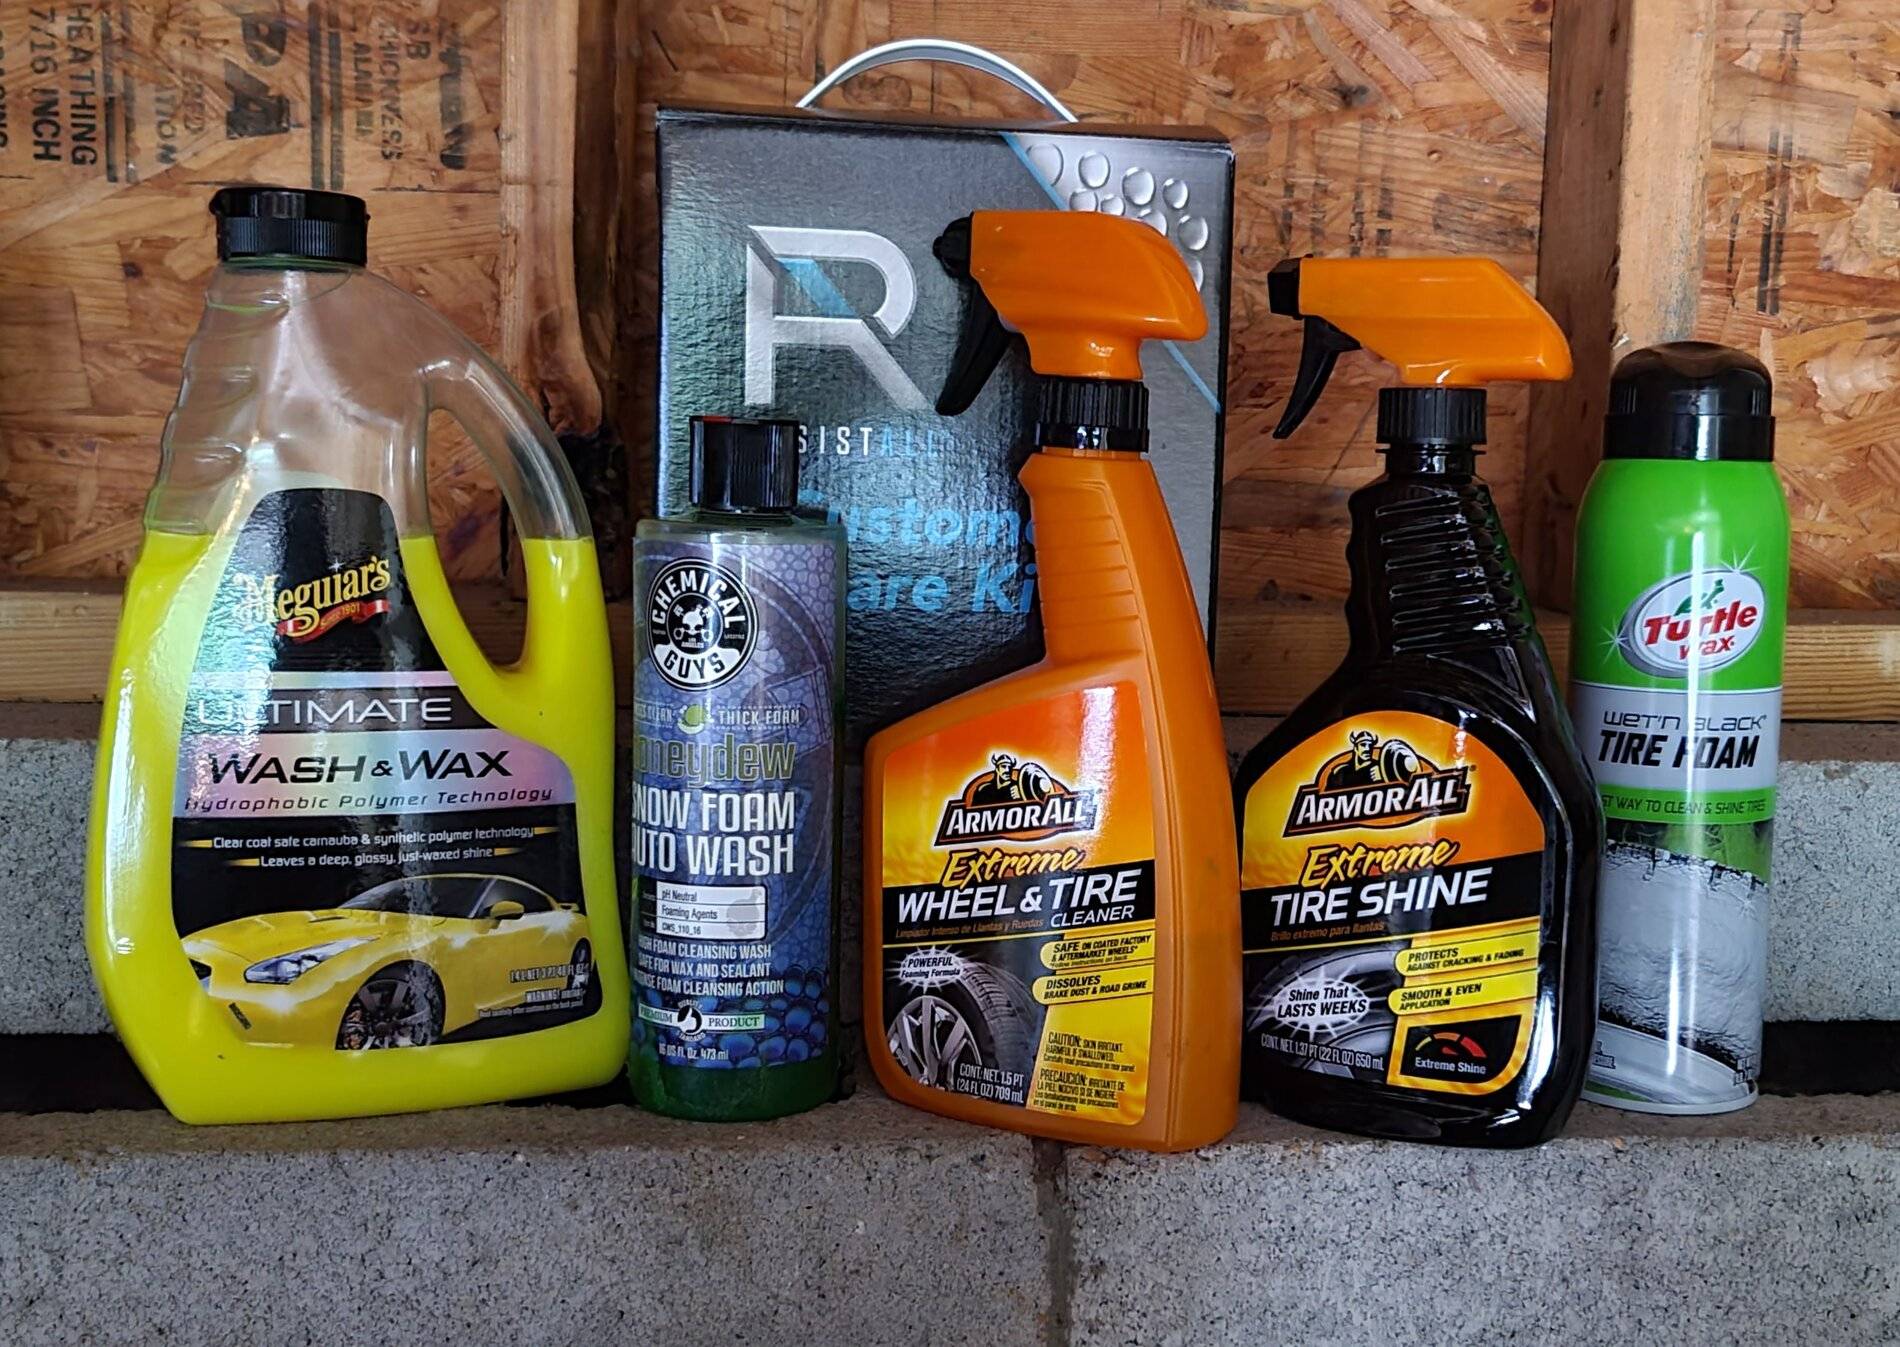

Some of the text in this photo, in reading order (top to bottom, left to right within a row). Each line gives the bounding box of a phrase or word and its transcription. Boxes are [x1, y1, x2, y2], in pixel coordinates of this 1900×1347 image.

[29, 7, 61, 161] 7/16 INCH
[798, 488, 1036, 547] ustom
[232, 555, 391, 638] Meguiar's
[652, 570, 746, 629] CHEMICAL
[1644, 599, 1758, 646] Turtle
[664, 649, 726, 680] GUYS
[718, 708, 800, 726] THICK FOAM
[1598, 729, 1760, 769] TIRE FOAM
[208, 748, 513, 784] WASH & WAX
[338, 793, 428, 809] Polymer
[437, 788, 553, 804] Technology
[1616, 797, 1642, 810] WAY
[1645, 799, 1661, 812] TO
[1664, 800, 1701, 815] CLEAN
[1704, 802, 1712, 814] &
[1715, 801, 1745, 815] SHINE
[702, 791, 795, 832] FOAM
[213, 826, 535, 849] Clear coat safe carnauba & synthetic polymer technology
[260, 855, 305, 867] Leaves
[308, 857, 316, 866] a
[397, 847, 460, 865] just-waxed
[463, 847, 494, 859] shine
[686, 834, 794, 876] WASH
[1302, 840, 1455, 890] Extreme
[942, 848, 1083, 890] Extreme
[898, 869, 1142, 924] WHEEL & TIRE
[1271, 866, 1493, 927] TIRE SHINE
[662, 904, 718, 921] Foaming Agents
[1050, 906, 1134, 928] CLEANER
[653, 939, 676, 956] FOAM
[678, 942, 737, 959] CLEANSING
[739, 944, 772, 960] WASH
[1053, 941, 1080, 954] SAFE
[1408, 948, 1459, 963] PROTECTS
[654, 956, 669, 972] FOR
[671, 960, 694, 977] WAX
[695, 963, 718, 978] AND
[720, 962, 772, 979] SEALANT
[908, 956, 954, 968] POWERFUL
[1407, 960, 1441, 972] AGAINST
[1442, 955, 1484, 968] CRACKING
[1485, 953, 1492, 962] &
[901, 968, 961, 979] Foaming Formula
[1046, 975, 1102, 990] DISSOLVES
[656, 974, 682, 994] FOAM
[683, 980, 743, 997] CLEANSING
[745, 979, 785, 997] ACTION
[1044, 989, 1069, 1000] BRAKE
[1070, 987, 1090, 998] DUST
[1099, 984, 1121, 994] ROAD
[1121, 980, 1148, 991] GRIME
[1288, 985, 1349, 1002] Shine That
[1400, 983, 1482, 1001] SMOOTH & EVEN
[1277, 999, 1367, 1019] LASTS WEEKS
[1399, 998, 1451, 1011] APPLICATION
[708, 1016, 761, 1028] PRODUCT
[701, 1048, 716, 1060] 473
[1309, 1044, 1318, 1059] PT
[1332, 1048, 1340, 1063] FL
[1355, 1052, 1371, 1069] 650
[1415, 1056, 1486, 1075] Extreme Shine
[970, 1080, 979, 1095] FL
[995, 1085, 1010, 1101] 709
[1013, 1073, 1025, 1088] PT
